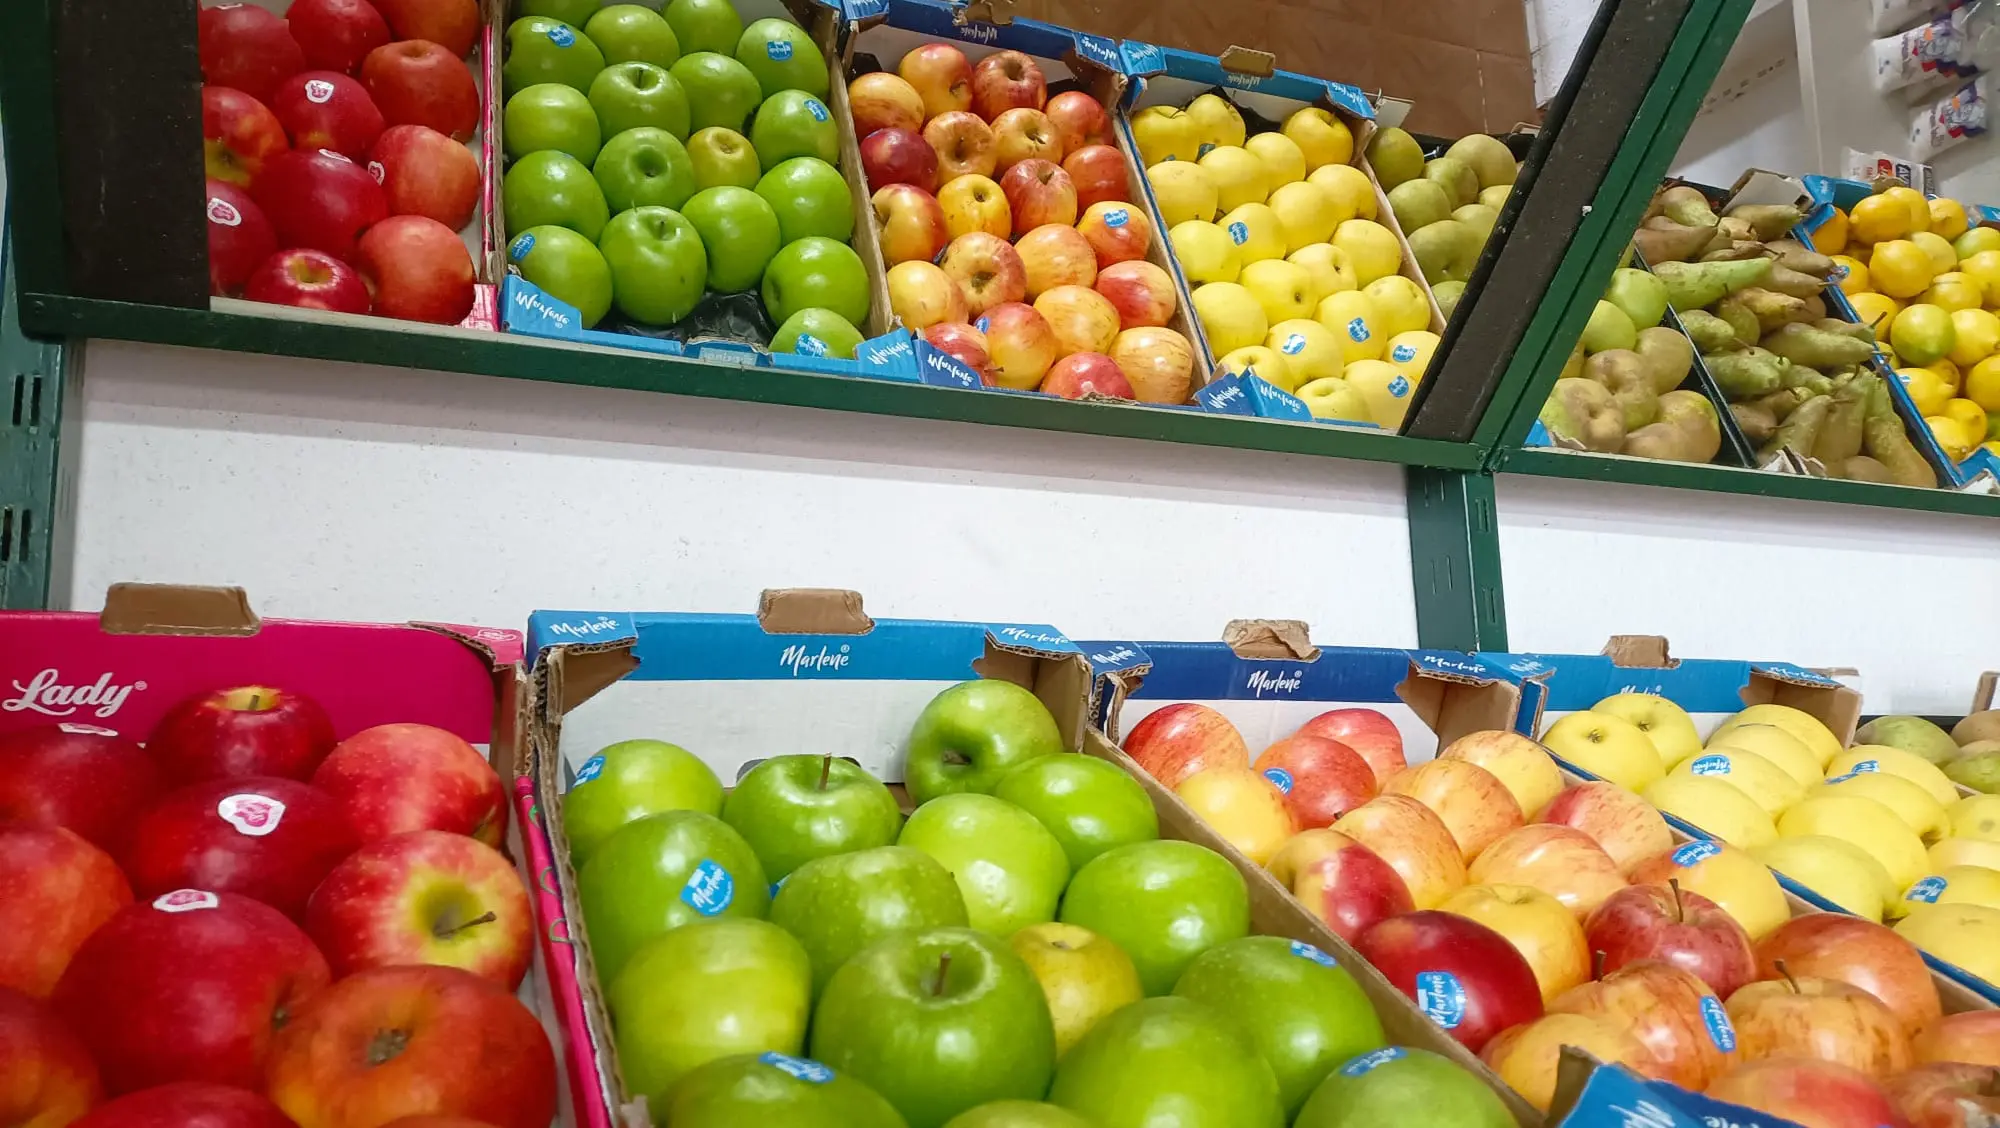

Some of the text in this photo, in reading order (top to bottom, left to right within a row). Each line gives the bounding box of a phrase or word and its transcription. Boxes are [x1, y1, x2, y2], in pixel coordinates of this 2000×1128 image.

[549, 619, 620, 638] Marlene
[1001, 627, 1069, 644] Marlene
[780, 645, 849, 677] Marlene
[1424, 655, 1486, 673] Marlene
[2, 668, 135, 717] Lady
[1247, 670, 1300, 698] Marlene
[1429, 974, 1453, 1026] Marlene
